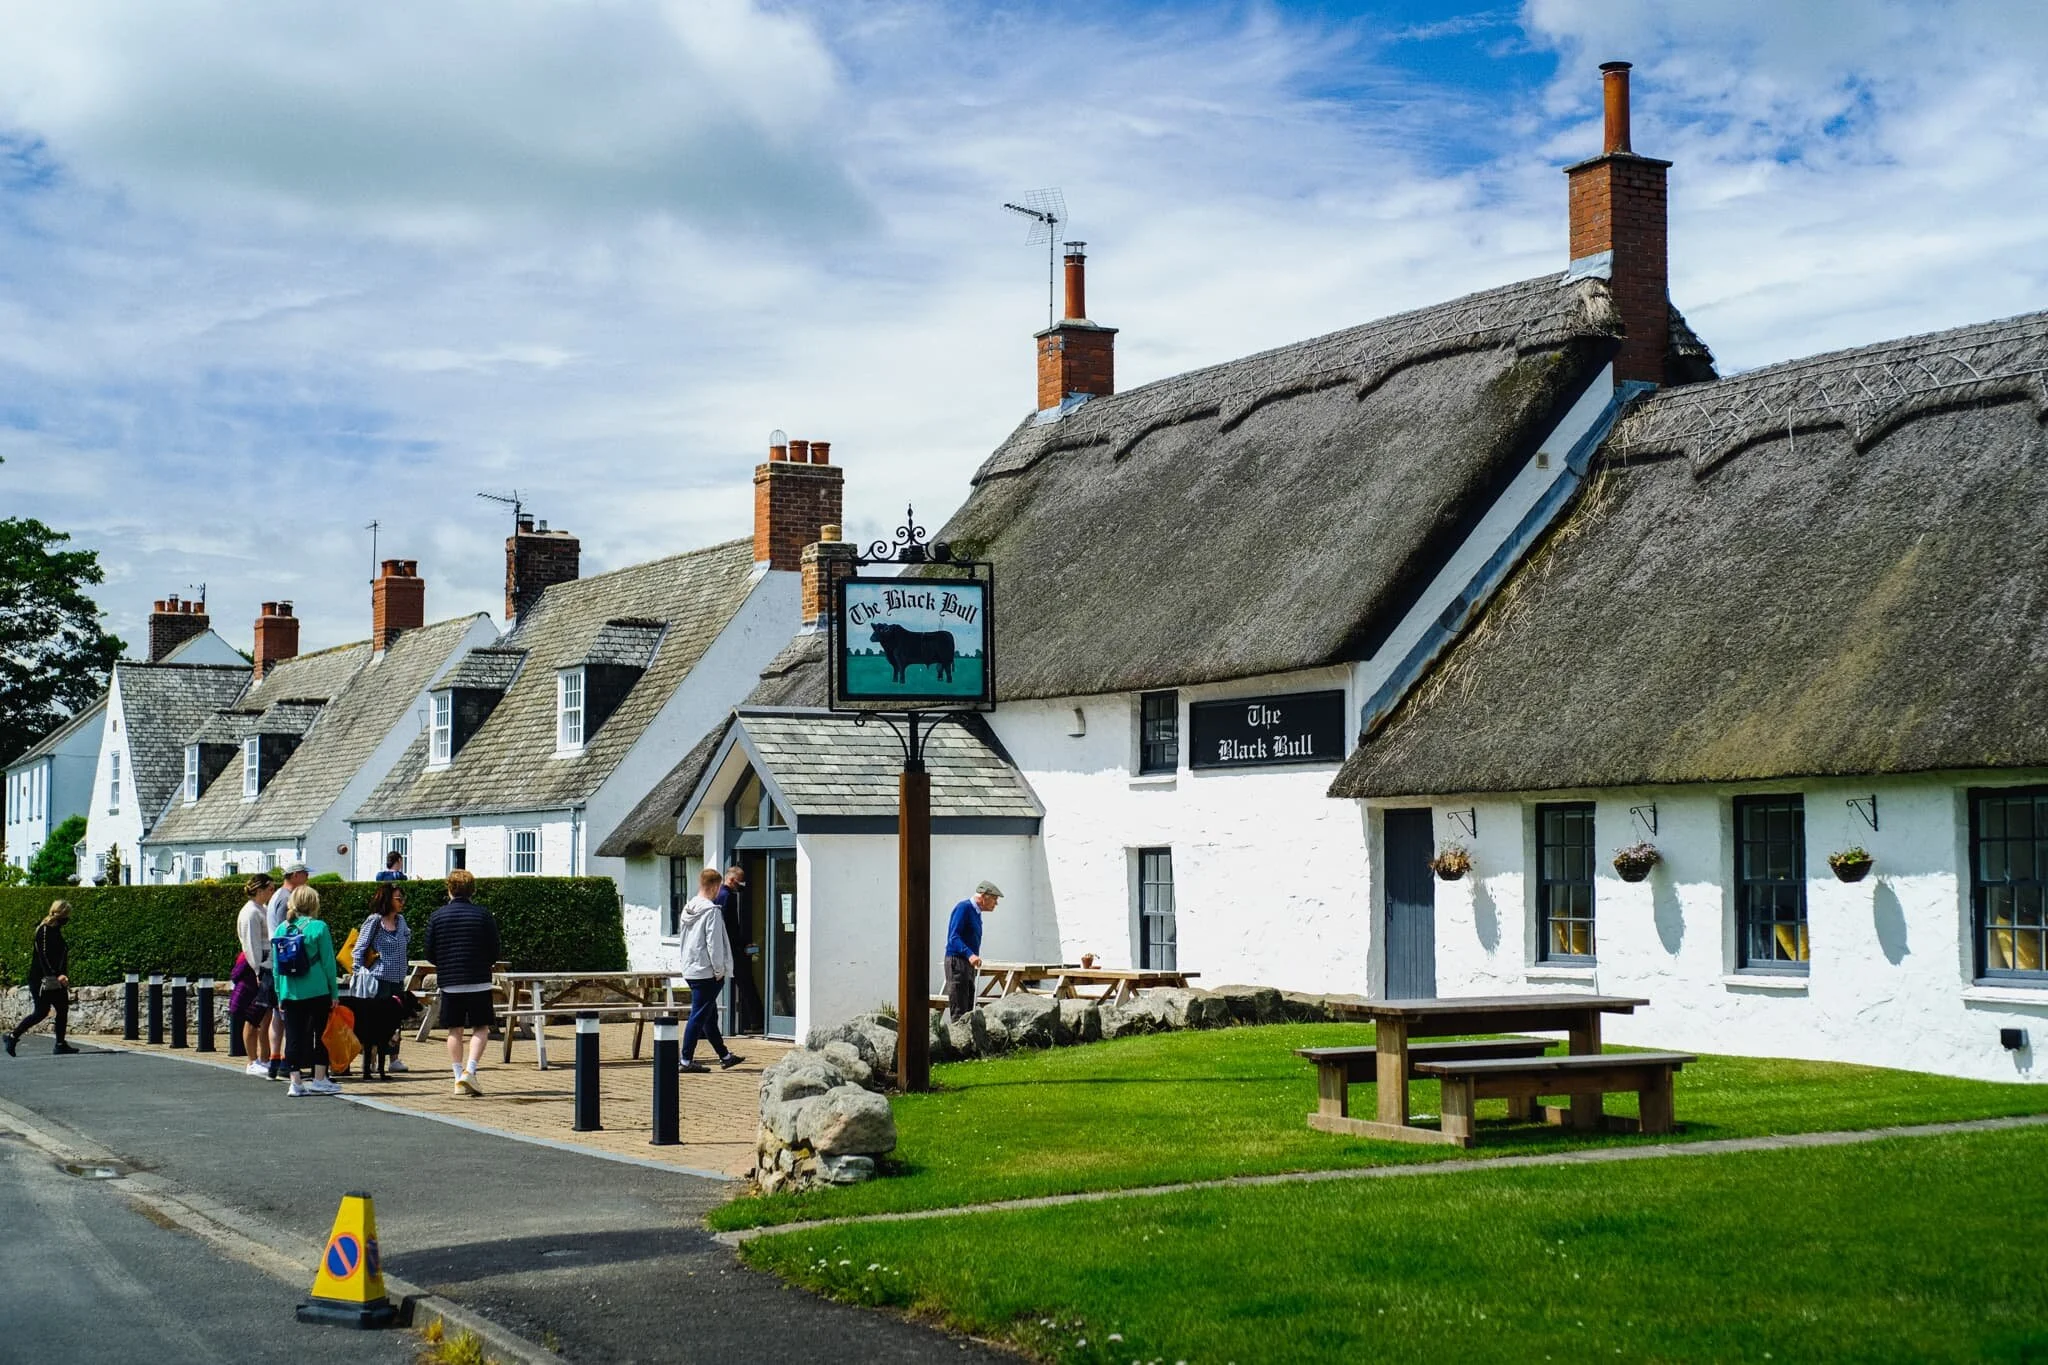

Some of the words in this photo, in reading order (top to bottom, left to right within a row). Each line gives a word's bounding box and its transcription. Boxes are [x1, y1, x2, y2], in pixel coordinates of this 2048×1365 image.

[848, 600, 881, 626] The
[882, 589, 936, 617] Black
[940, 591, 979, 625] Bull
[1247, 704, 1282, 730] The
[1218, 737, 1268, 761] Black
[1272, 733, 1314, 757] Bull
